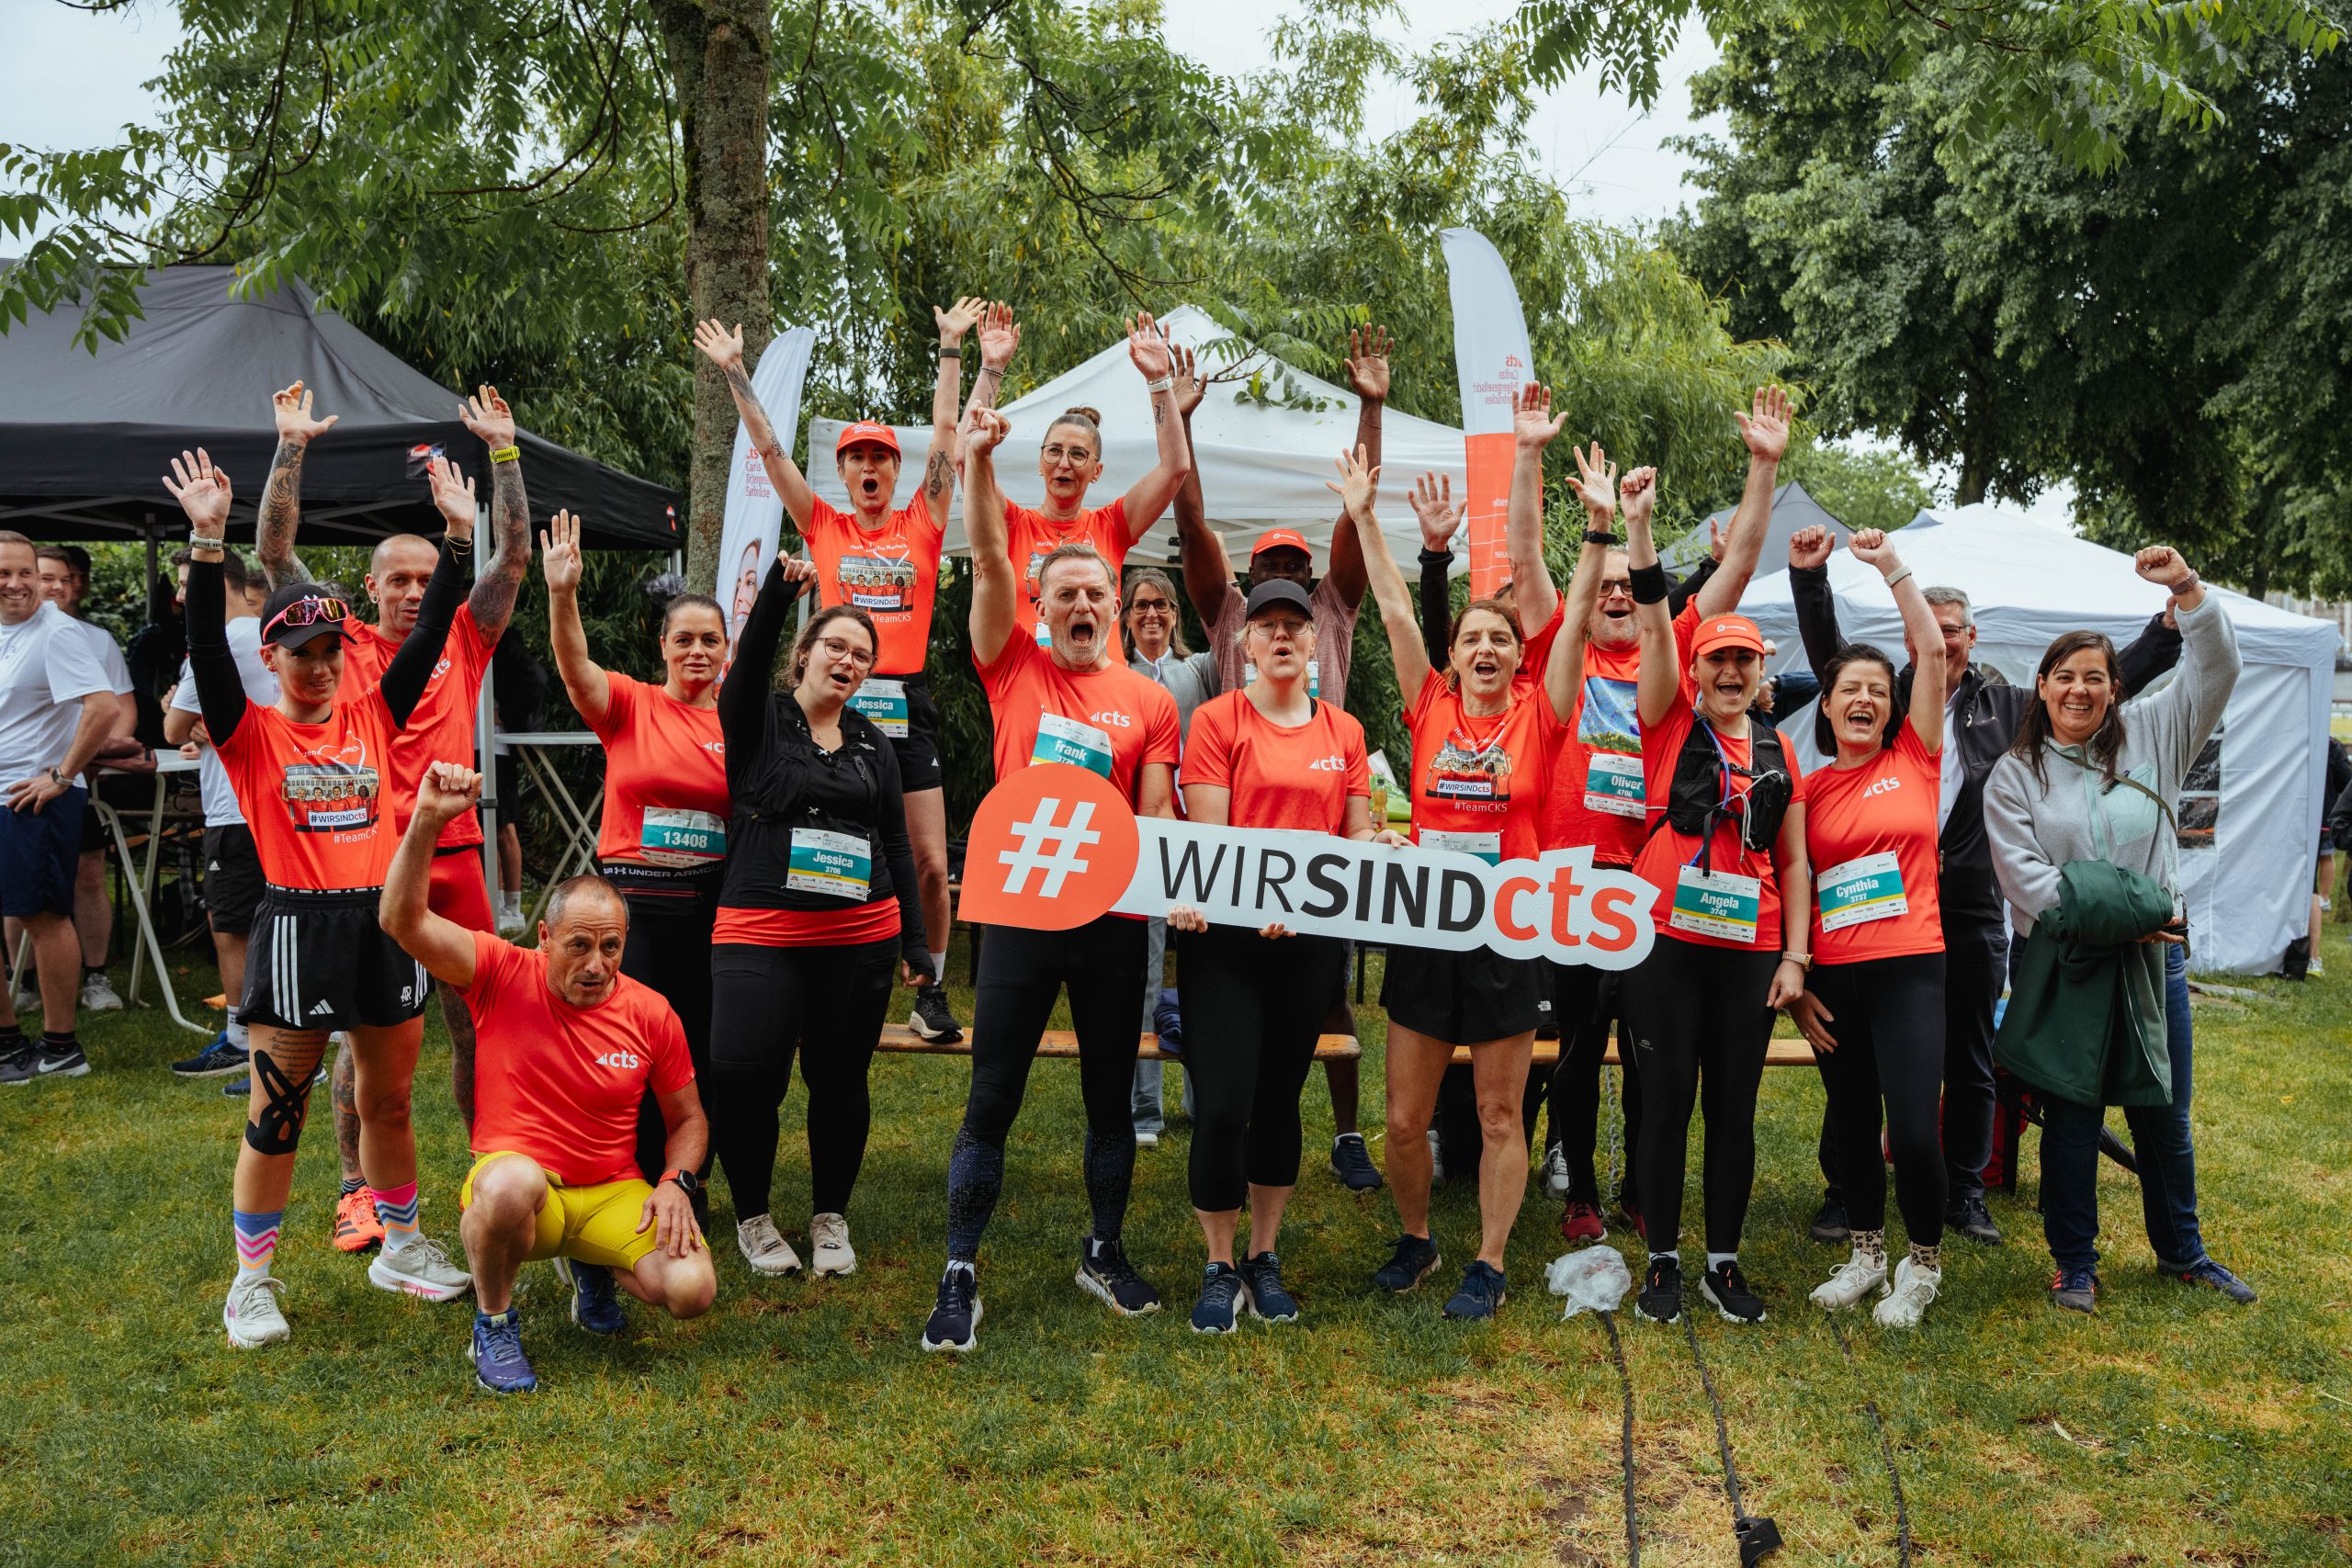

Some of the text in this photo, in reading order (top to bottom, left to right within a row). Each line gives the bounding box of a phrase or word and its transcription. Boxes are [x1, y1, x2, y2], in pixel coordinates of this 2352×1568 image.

[854, 595, 899, 606] #WIRSINDcts
[870, 613, 911, 624] #TeamCKS
[855, 699, 894, 711] Jessica
[1101, 710, 1131, 728] cts
[1054, 739, 1088, 761] Frank
[1319, 754, 1345, 772] cts
[1439, 782, 1490, 793] #WIRSINDcts
[1611, 774, 1643, 790] Oliver
[1871, 775, 1902, 795] cts
[1616, 788, 1633, 797] 4700
[1454, 802, 1508, 813] #TeamCKS
[311, 810, 367, 824] #WIRSINDcts
[662, 830, 707, 849] 13408
[813, 851, 854, 869] Jessica
[628, 865, 721, 878] UNDER ARMOU
[1836, 878, 1879, 898] Cynthia
[1700, 892, 1739, 909] Angela
[1850, 893, 1867, 904] 3737
[1710, 907, 1727, 917] 3742
[609, 1050, 639, 1069] cts
